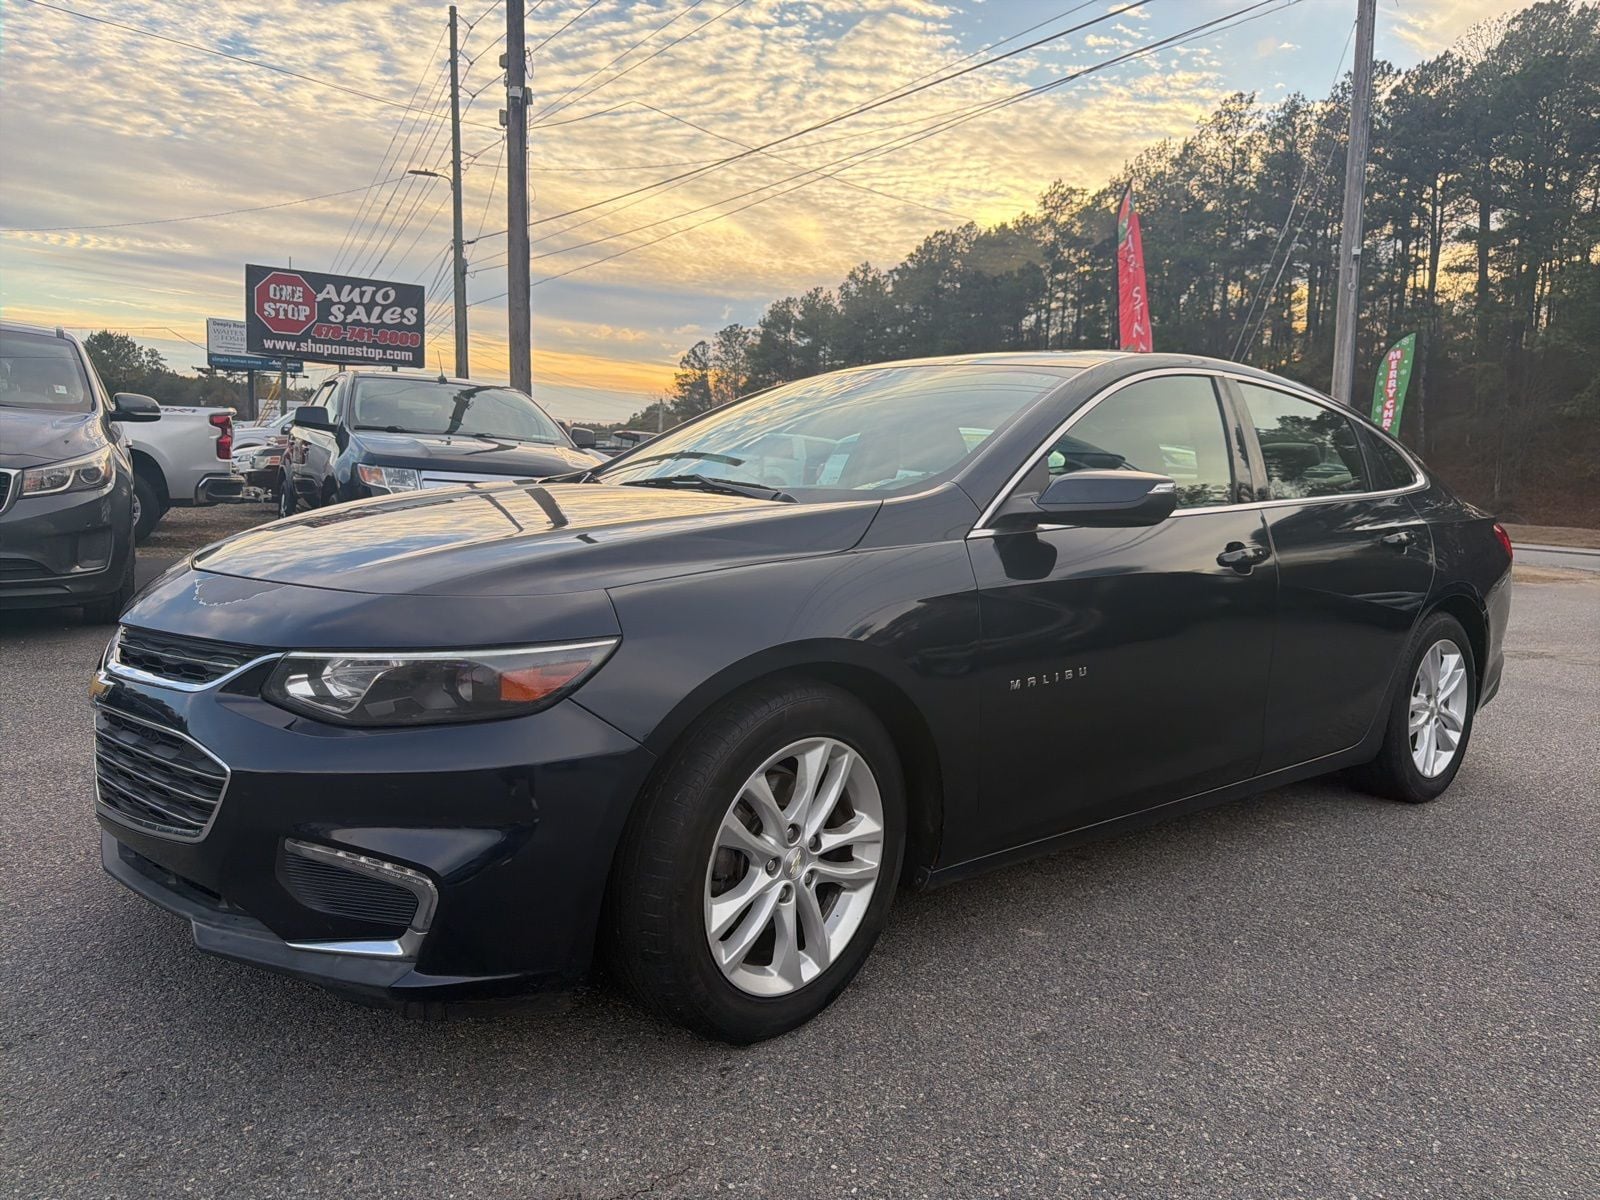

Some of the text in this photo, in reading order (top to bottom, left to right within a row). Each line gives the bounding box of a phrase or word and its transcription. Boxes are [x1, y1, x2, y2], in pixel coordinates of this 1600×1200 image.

[269, 283, 304, 302] ONE
[315, 283, 397, 305] AUTO
[263, 302, 310, 321] STOP
[328, 304, 418, 326] SALES
[263, 338, 413, 361] www.shoponestop.com
[1381, 350, 1401, 432] MERRY CHR
[1010, 667, 1087, 691] MALIBU
